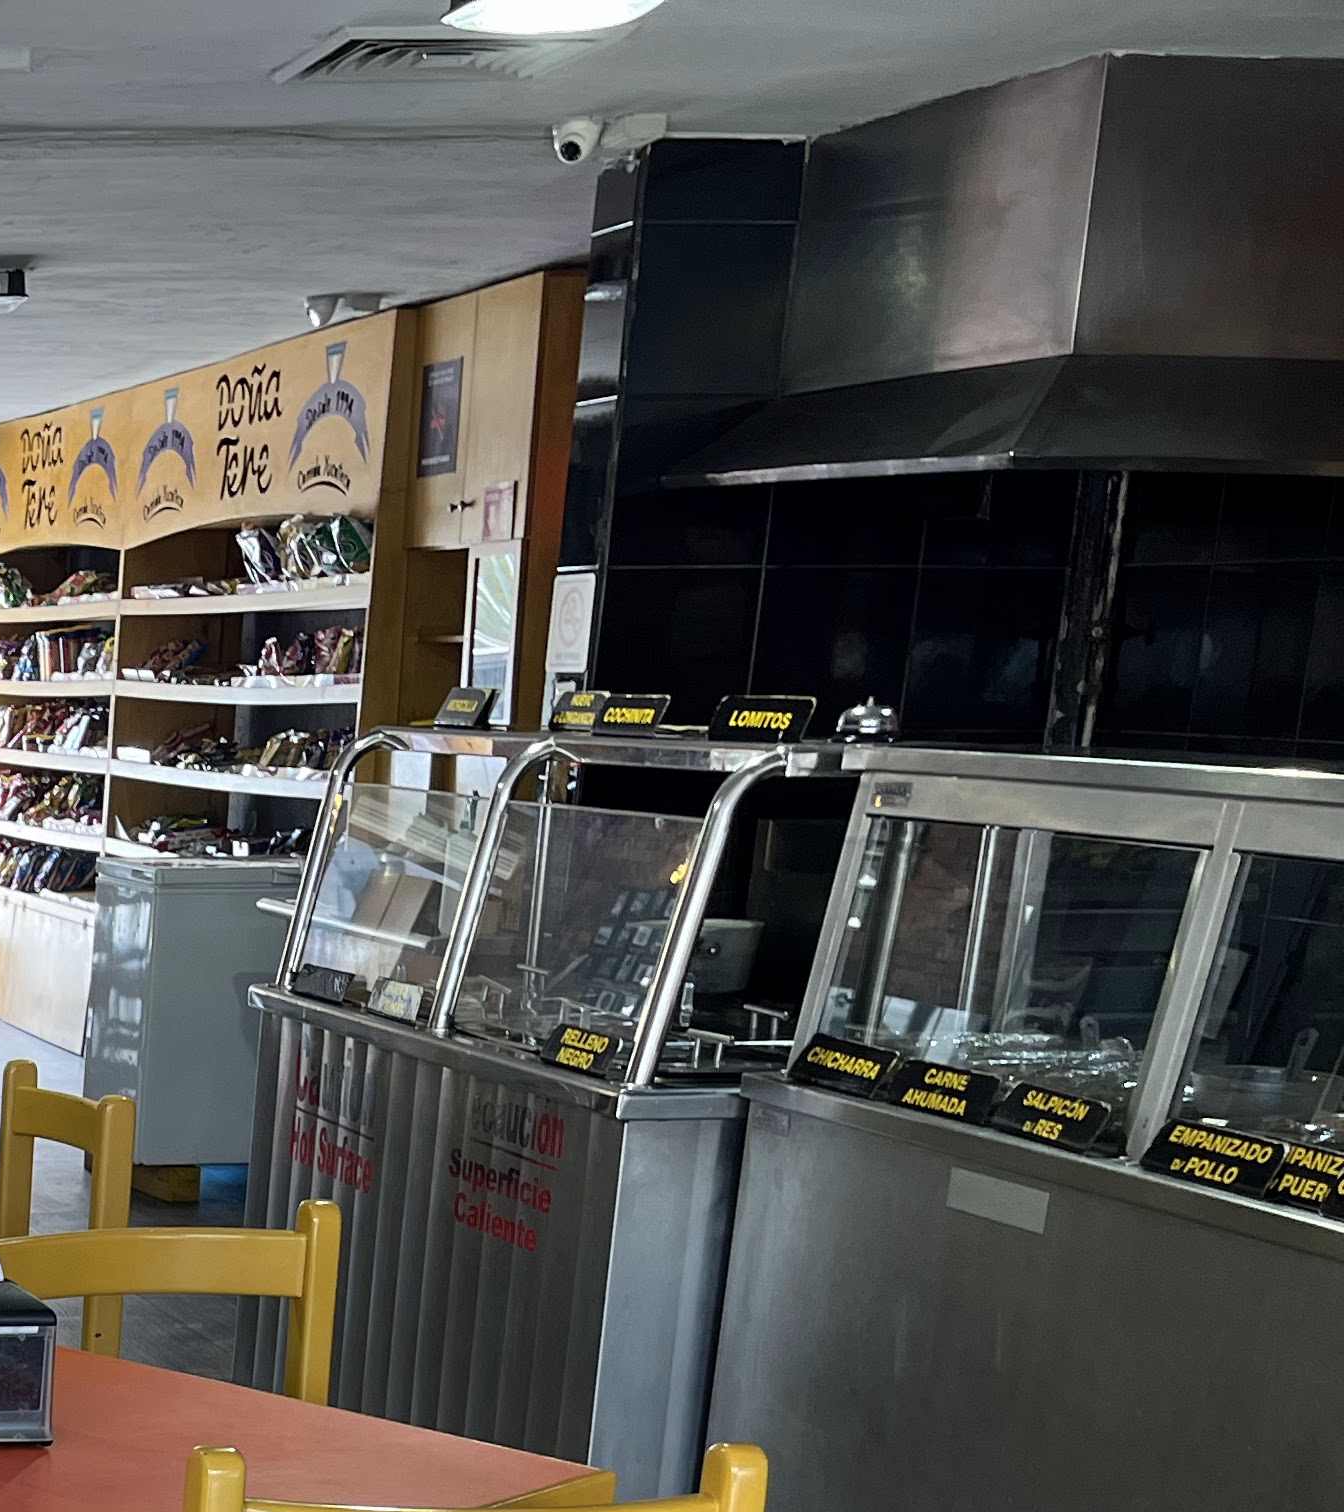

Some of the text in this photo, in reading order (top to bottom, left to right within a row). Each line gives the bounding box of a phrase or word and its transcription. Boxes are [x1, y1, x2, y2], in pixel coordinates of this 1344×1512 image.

[216, 363, 283, 432] Doña
[216, 436, 273, 500] Tere
[21, 479, 58, 530] Tere
[728, 710, 793, 730] LOMITOS
[555, 1046, 595, 1071] NEGRO
[560, 1028, 610, 1054] RELLENO
[806, 1046, 881, 1081] CHICHARRA
[924, 1068, 970, 1092] CARNE
[901, 1087, 968, 1118] AHUMADA
[1022, 1089, 1091, 1123] SALPICÓN
[290, 1109, 373, 1195] Hot Surface
[1168, 1124, 1274, 1165] EMPANIZADO
[448, 1148, 553, 1214] Superficie
[454, 1191, 538, 1252] Caliente
